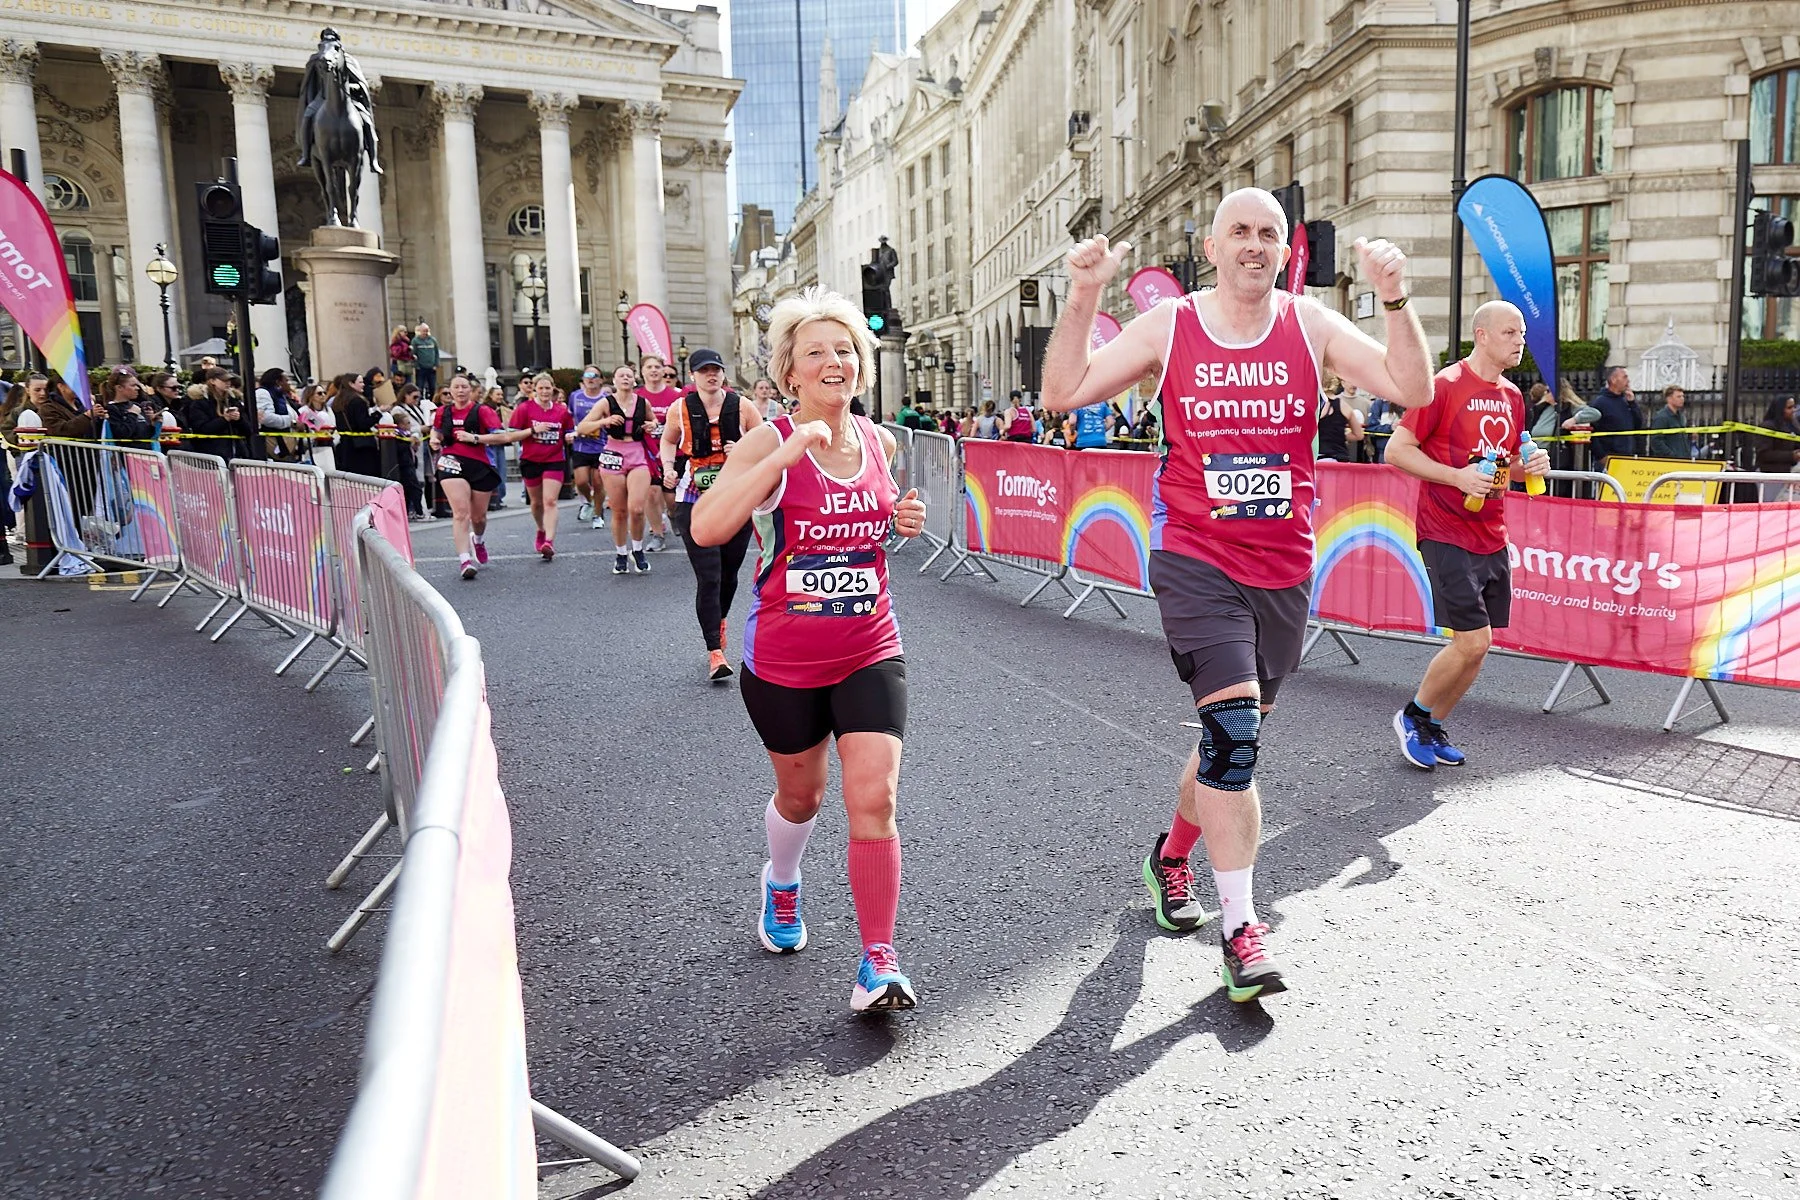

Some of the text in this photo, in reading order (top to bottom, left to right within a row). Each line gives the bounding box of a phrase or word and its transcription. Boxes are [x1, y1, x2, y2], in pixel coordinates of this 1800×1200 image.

[1484, 216, 1540, 319] MOORE Kingston Smith
[1194, 361, 1289, 388] SEAMUS
[1179, 393, 1306, 424] Tommy's
[1185, 429, 1197, 438] The
[1197, 428, 1240, 438] pregnancy
[1241, 426, 1256, 435] and
[1257, 426, 1279, 436] baby
[1232, 456, 1267, 465] SEAMUS
[996, 469, 1058, 507] Tommy's
[1217, 473, 1281, 495] 9026
[819, 490, 879, 515] JEAN
[825, 555, 849, 563] JEAN
[802, 571, 869, 593] 9025
[1563, 596, 1590, 609] and
[1592, 596, 1626, 617] baby
[1629, 602, 1677, 621] charity
